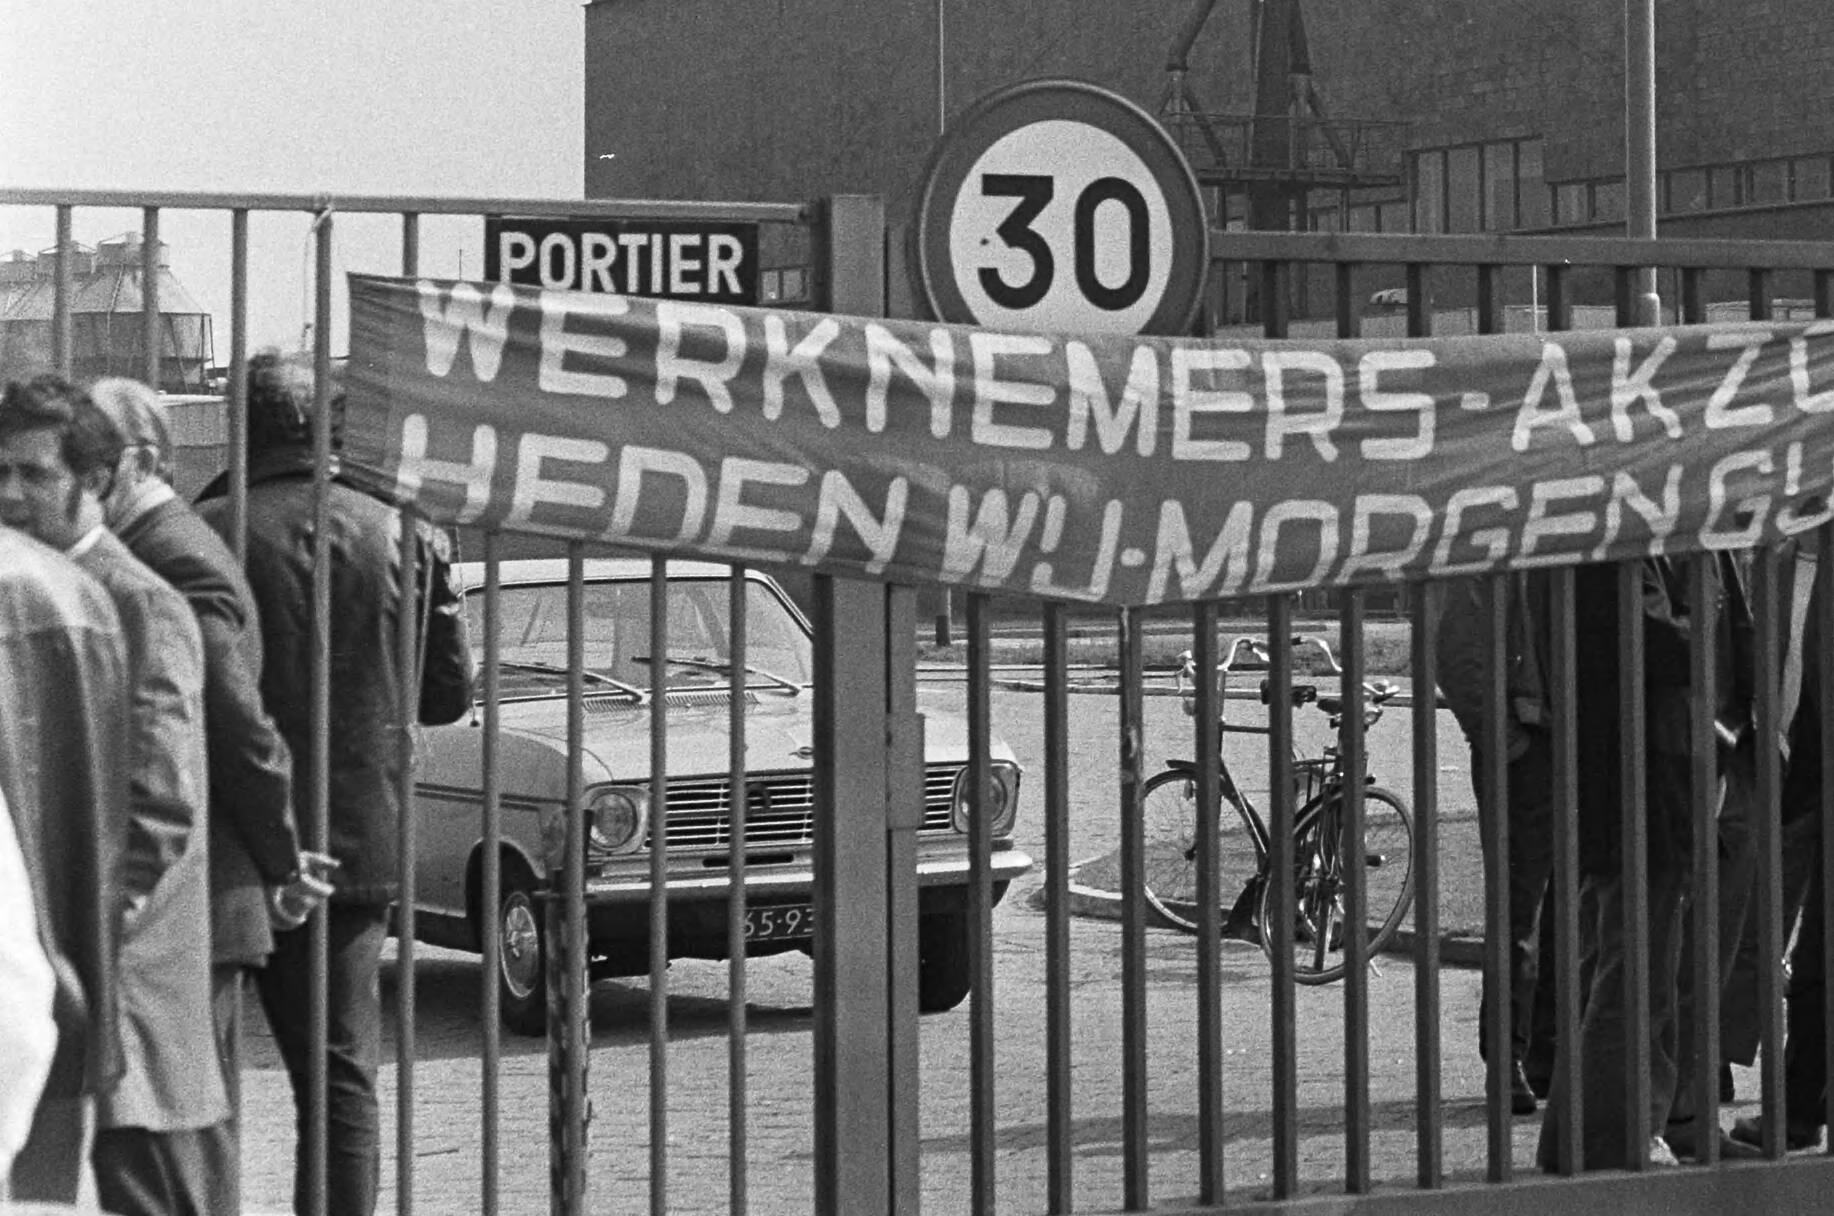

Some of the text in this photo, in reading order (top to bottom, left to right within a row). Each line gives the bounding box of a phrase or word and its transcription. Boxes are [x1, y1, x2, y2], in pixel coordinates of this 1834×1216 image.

[498, 231, 745, 295] PORTIER
[976, 172, 1152, 312] 30
[394, 411, 909, 576] HEDEN
